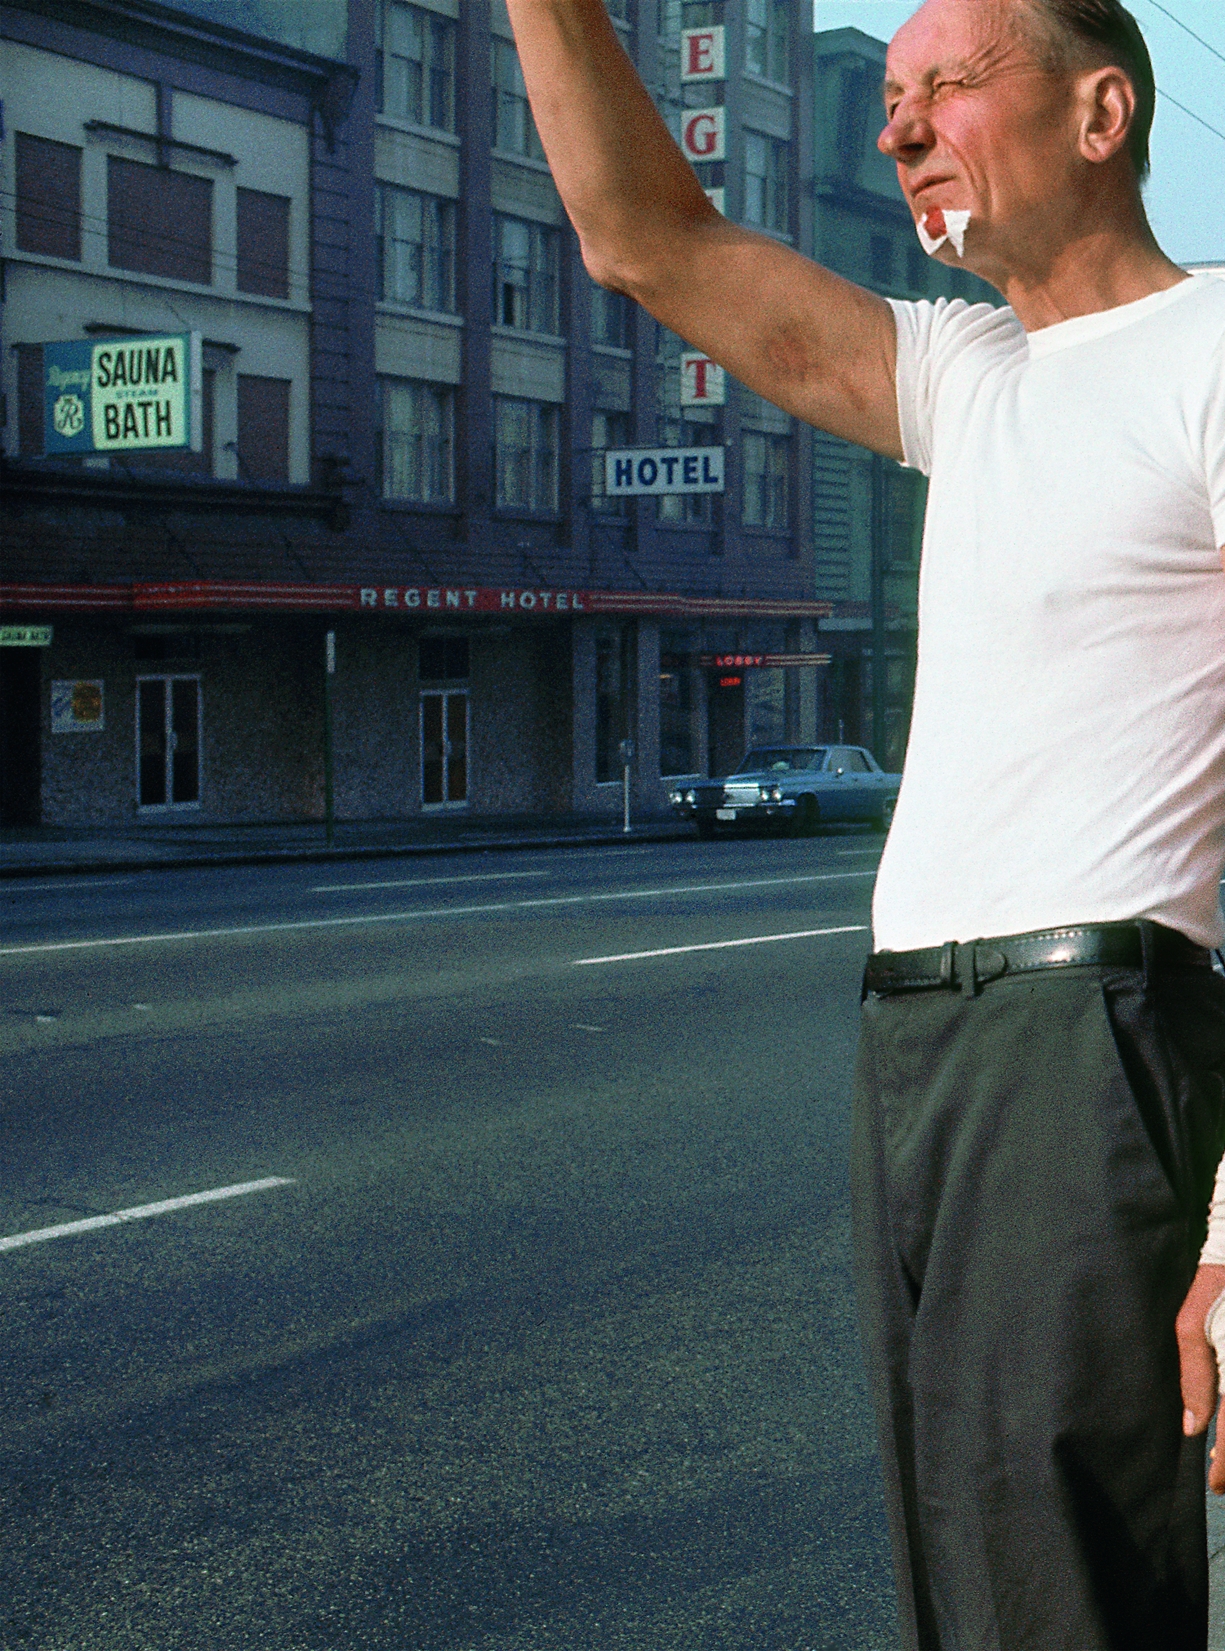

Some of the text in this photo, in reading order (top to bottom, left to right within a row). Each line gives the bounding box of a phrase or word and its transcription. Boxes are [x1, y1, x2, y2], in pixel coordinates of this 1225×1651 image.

[98, 347, 177, 388] SAUNA
[104, 400, 172, 440] BATH
[615, 456, 719, 487] HOTEL
[360, 588, 584, 610] REGENT HOTEL
[716, 655, 762, 667] LOBBY
